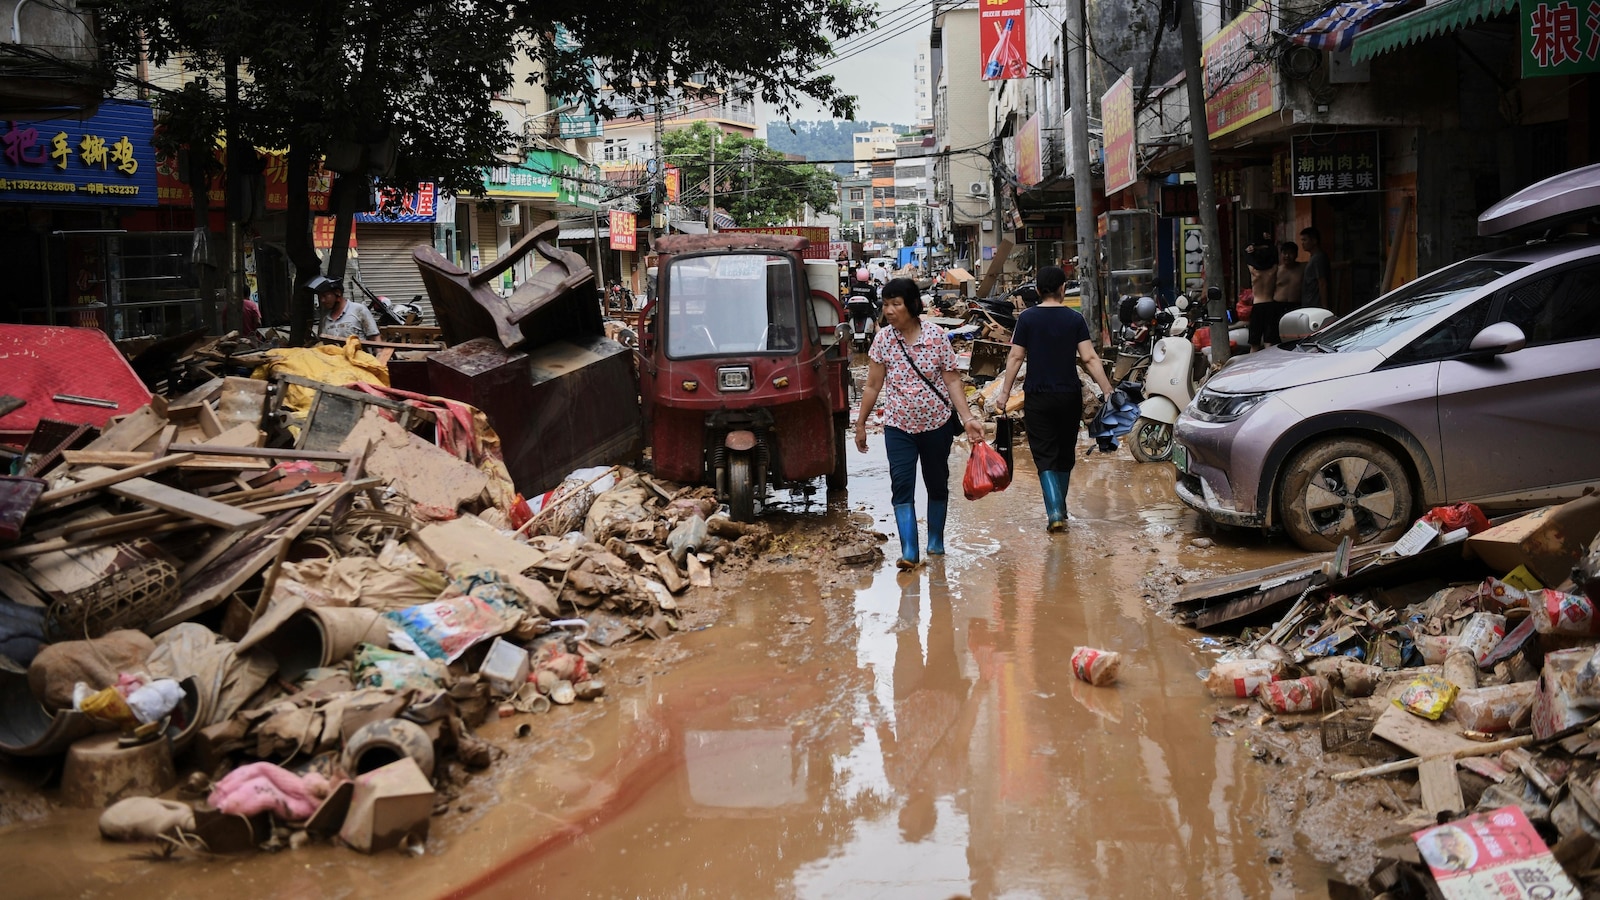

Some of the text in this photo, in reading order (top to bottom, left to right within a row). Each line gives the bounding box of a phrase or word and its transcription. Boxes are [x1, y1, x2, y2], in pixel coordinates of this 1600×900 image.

[1297, 153, 1374, 173] 潮州肉丸
[1298, 171, 1374, 190] 新鲜美味
